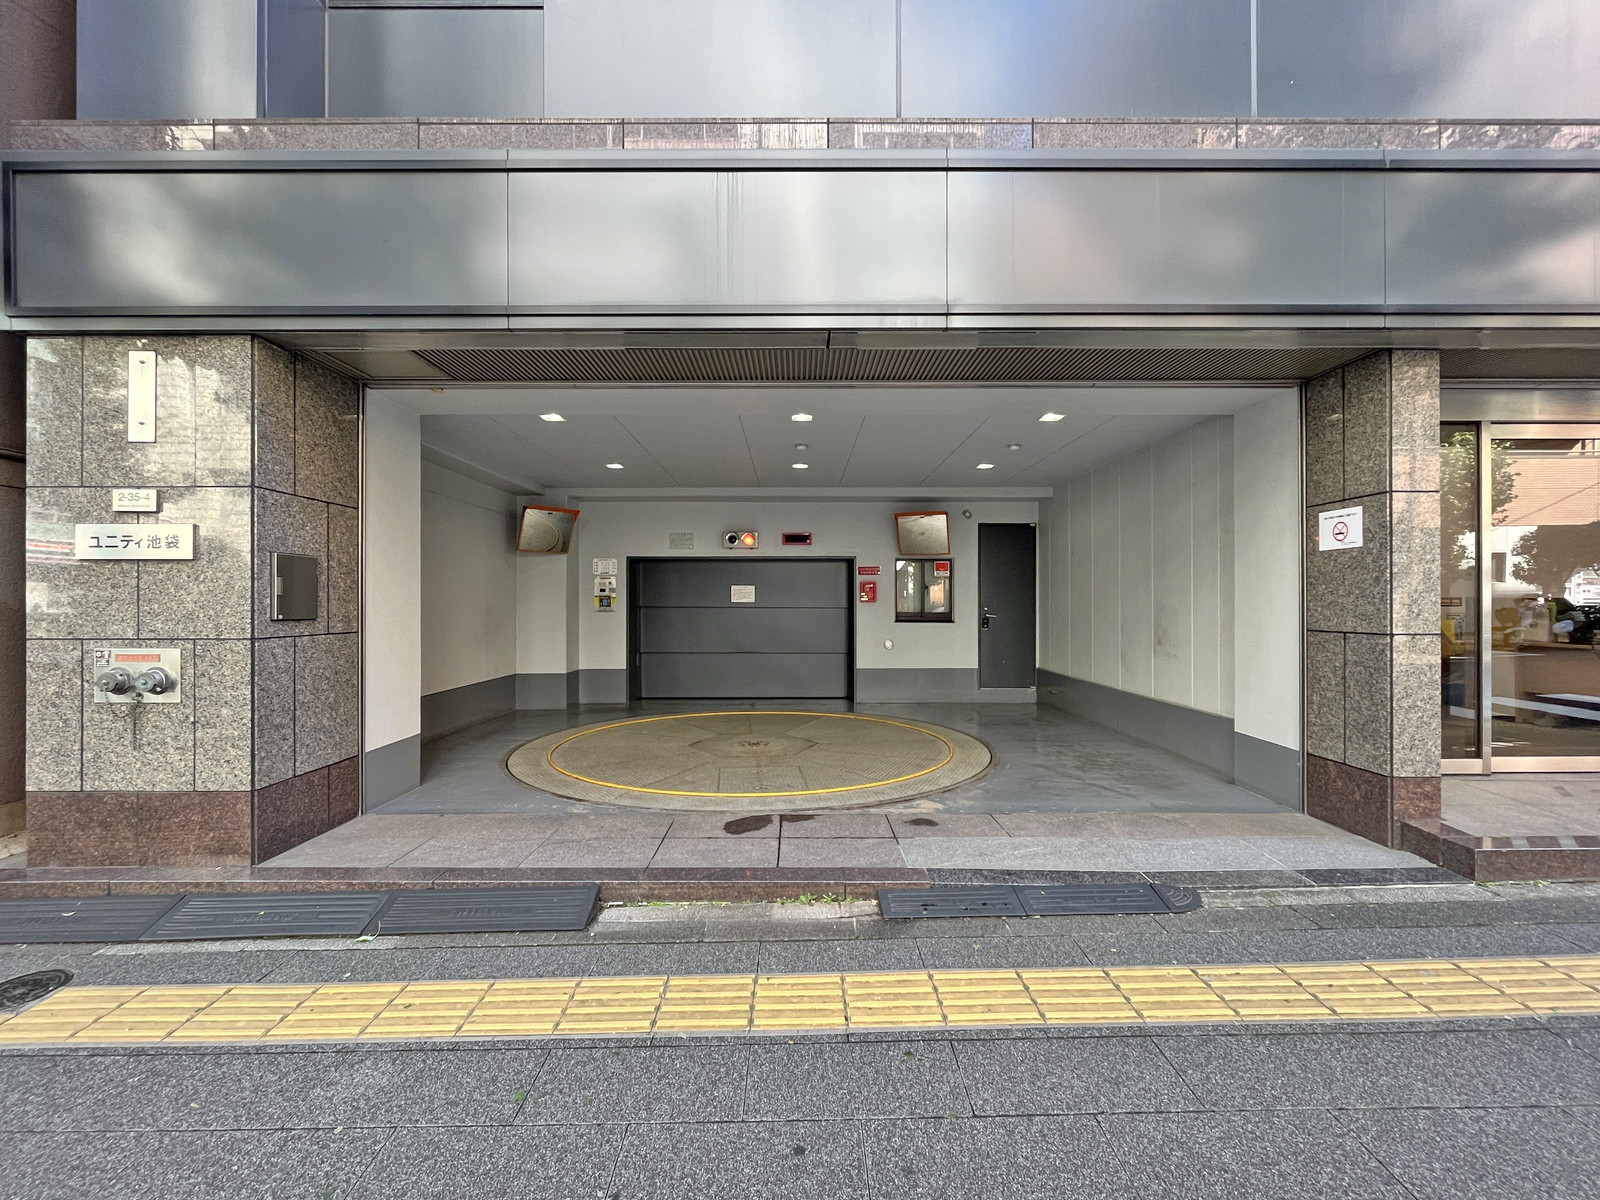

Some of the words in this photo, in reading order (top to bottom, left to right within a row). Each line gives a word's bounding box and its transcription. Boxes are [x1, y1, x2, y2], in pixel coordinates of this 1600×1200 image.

[118, 492, 151, 502] 2-35-4
[88, 534, 180, 549] ユニティ池袋
